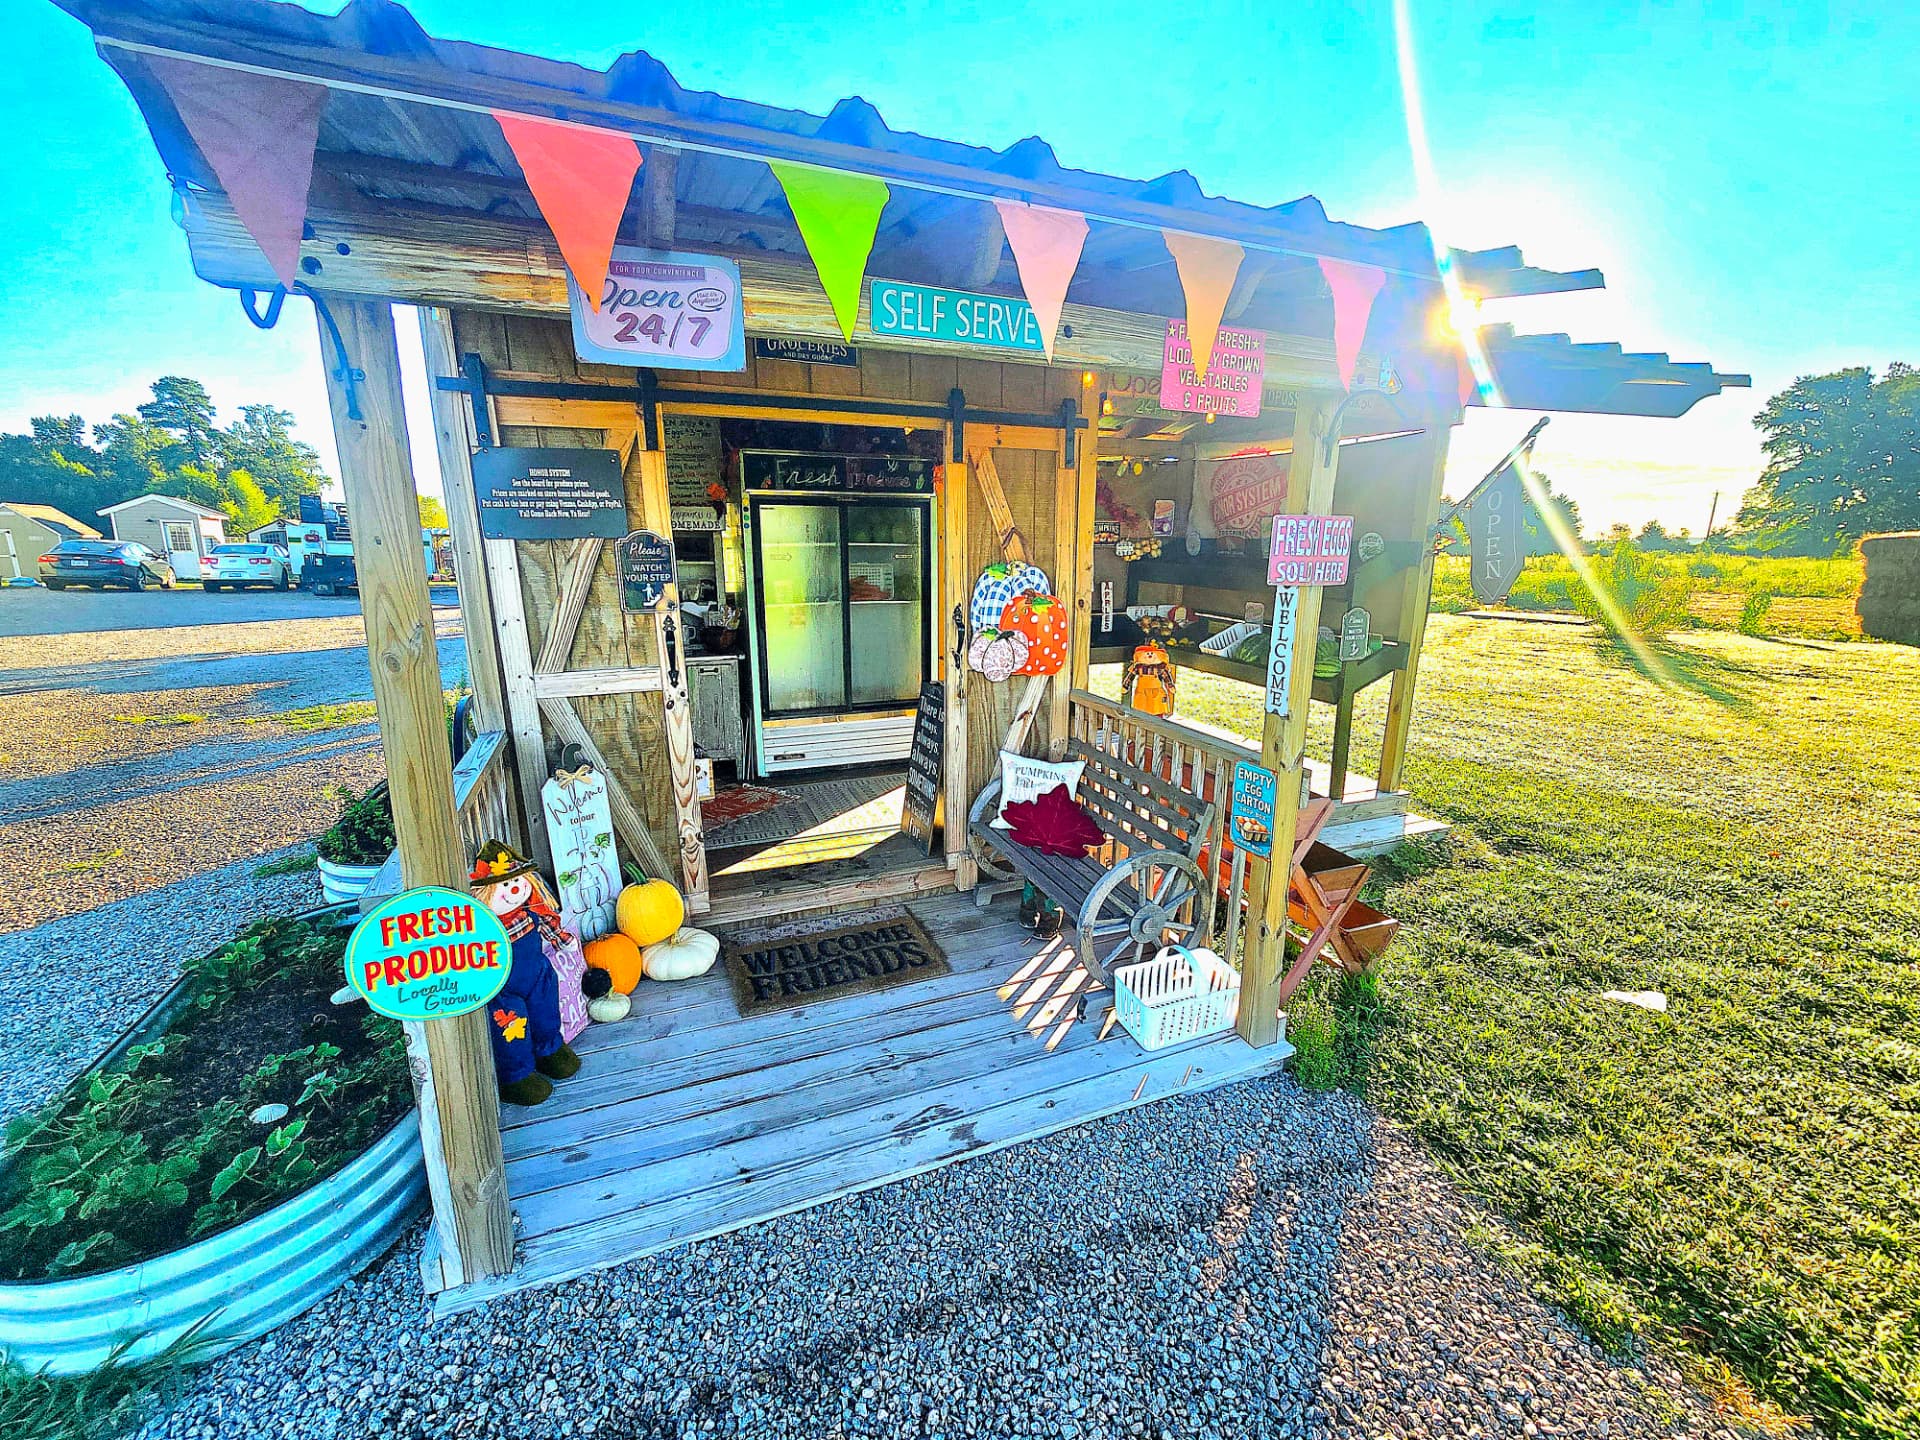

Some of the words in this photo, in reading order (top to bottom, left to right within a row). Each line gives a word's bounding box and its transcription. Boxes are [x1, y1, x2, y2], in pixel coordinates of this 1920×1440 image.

[615, 265, 629, 273] FOR
[632, 265, 650, 274] YOUR
[653, 266, 700, 278] CONVENIENCE
[586, 278, 683, 314] Open
[882, 289, 946, 333] SELF
[955, 299, 1037, 344] SERVE
[613, 311, 712, 349] 24/7
[767, 338, 848, 357] GROCERIES
[1218, 331, 1251, 351] FRESH
[1168, 345, 1220, 369] LOCY
[1223, 353, 1260, 373] GROWN
[1179, 369, 1248, 391] VEGETABLES
[1184, 392, 1192, 408] &
[1198, 396, 1238, 413] FRUITS
[549, 468, 571, 477] SYSTEM
[776, 459, 840, 489] Fresh
[492, 488, 508, 497] Prices
[518, 489, 536, 497] marked
[522, 478, 531, 487] the
[531, 478, 545, 487] board
[554, 479, 573, 489] produce
[492, 499, 504, 508] cash
[1237, 477, 1280, 512] SYSTEM
[672, 520, 720, 529] OMEMADE
[1485, 490, 1503, 580] OPEN
[1274, 519, 1321, 556] FRESH
[1322, 519, 1352, 556] EGGS
[630, 542, 662, 556] Please
[624, 573, 649, 582] YOUR
[650, 572, 671, 582] STEP
[632, 563, 662, 573] WATCH
[1276, 561, 1313, 582] SOLD
[1314, 562, 1344, 582] HERE
[1270, 592, 1294, 707] WELCOME
[920, 695, 938, 719] There
[1015, 766, 1066, 781] PUMPKINS
[1238, 768, 1273, 789] EMPTY
[1245, 783, 1262, 797] EGG
[546, 785, 604, 827] Welcome
[1235, 791, 1271, 814] CARTON
[569, 817, 579, 826] to
[581, 812, 596, 823] our
[379, 904, 474, 947] FRESH
[740, 924, 913, 975] WELCOME
[364, 941, 500, 992] PRODUCE
[748, 941, 931, 1001] FRIENDS
[397, 977, 458, 1004] Locally
[424, 993, 481, 1011] Grown
